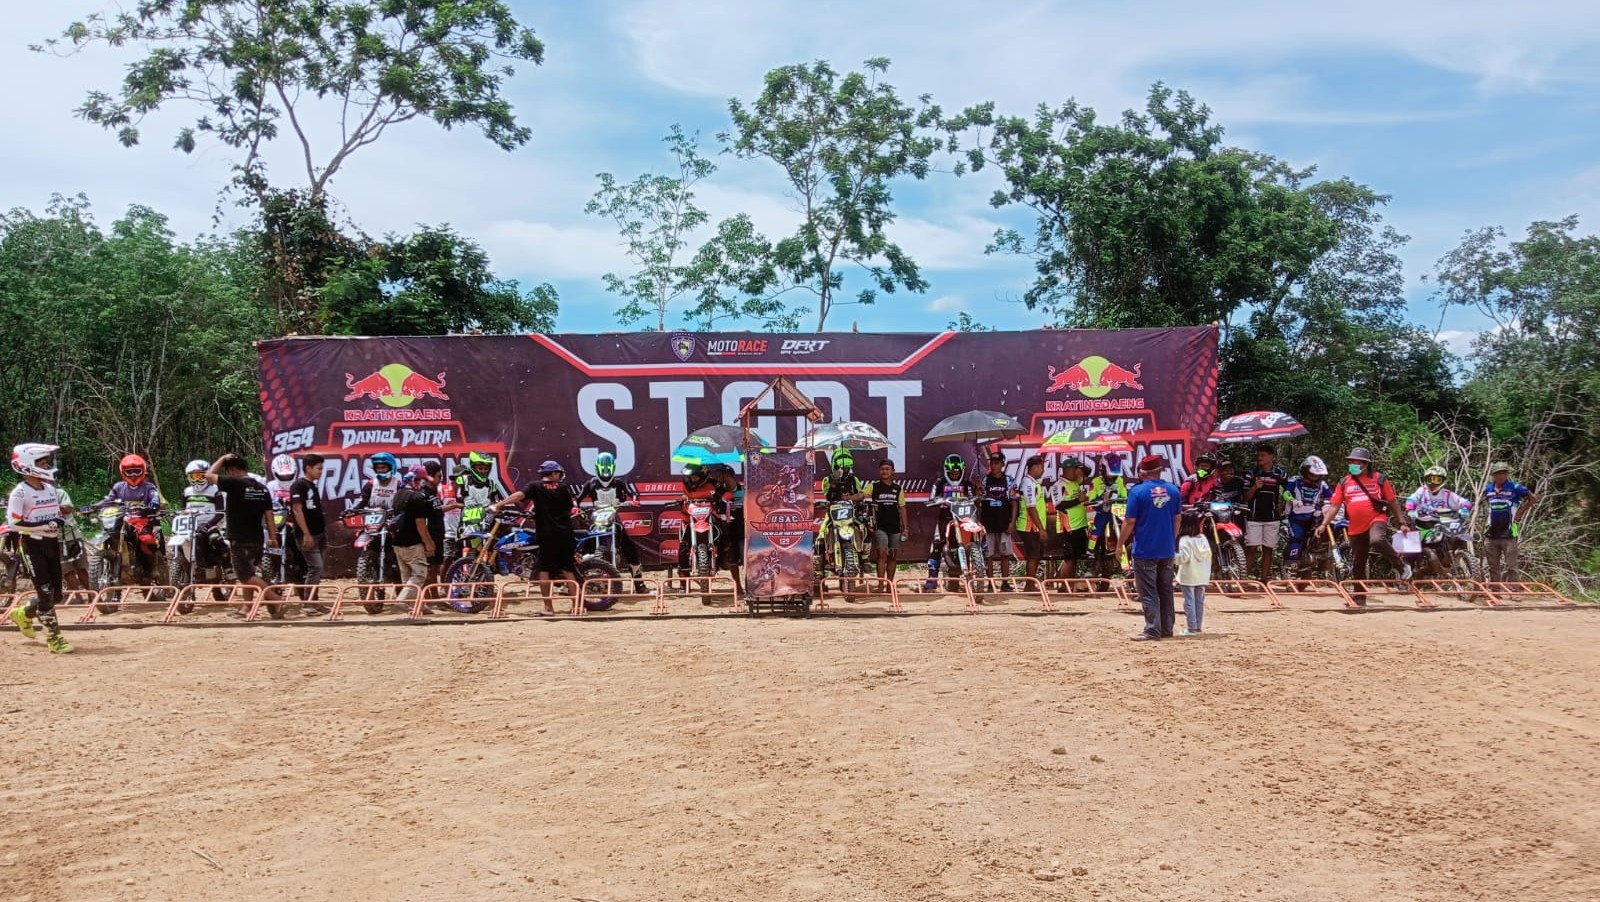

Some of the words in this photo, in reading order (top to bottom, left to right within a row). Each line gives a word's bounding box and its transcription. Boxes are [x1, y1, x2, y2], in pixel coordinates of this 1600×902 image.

[1046, 398, 1144, 411] KRATINGDAENG
[344, 409, 451, 421] KRATINGDAENG
[272, 426, 315, 454] 354
[341, 428, 400, 449] DANIEL
[401, 428, 452, 448] PUTRA
[771, 515, 798, 523] USAC
[837, 509, 849, 519] 12
